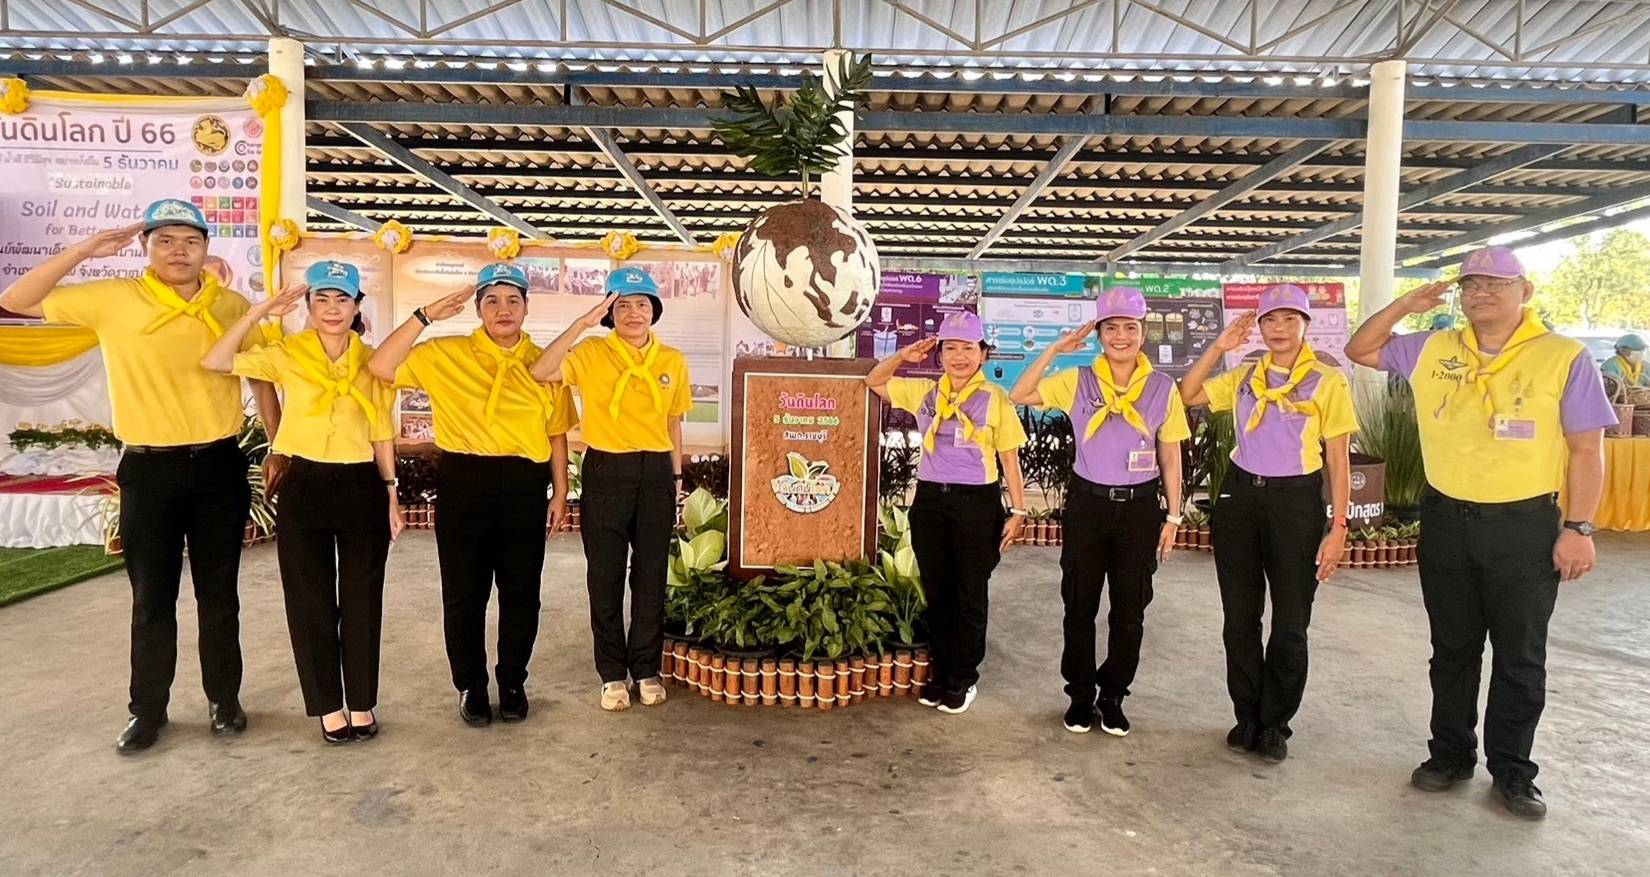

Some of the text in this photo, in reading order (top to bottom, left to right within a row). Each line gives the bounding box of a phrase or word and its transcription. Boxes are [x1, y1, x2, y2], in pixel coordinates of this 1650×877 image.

[0, 112, 175, 144] นดินโลก ปี 66
[104, 157, 112, 168] 5
[118, 154, 179, 170] ธันวาคม
[21, 200, 146, 219] Soil and Wat
[45, 223, 105, 236] for Bett
[773, 414, 780, 424] 5
